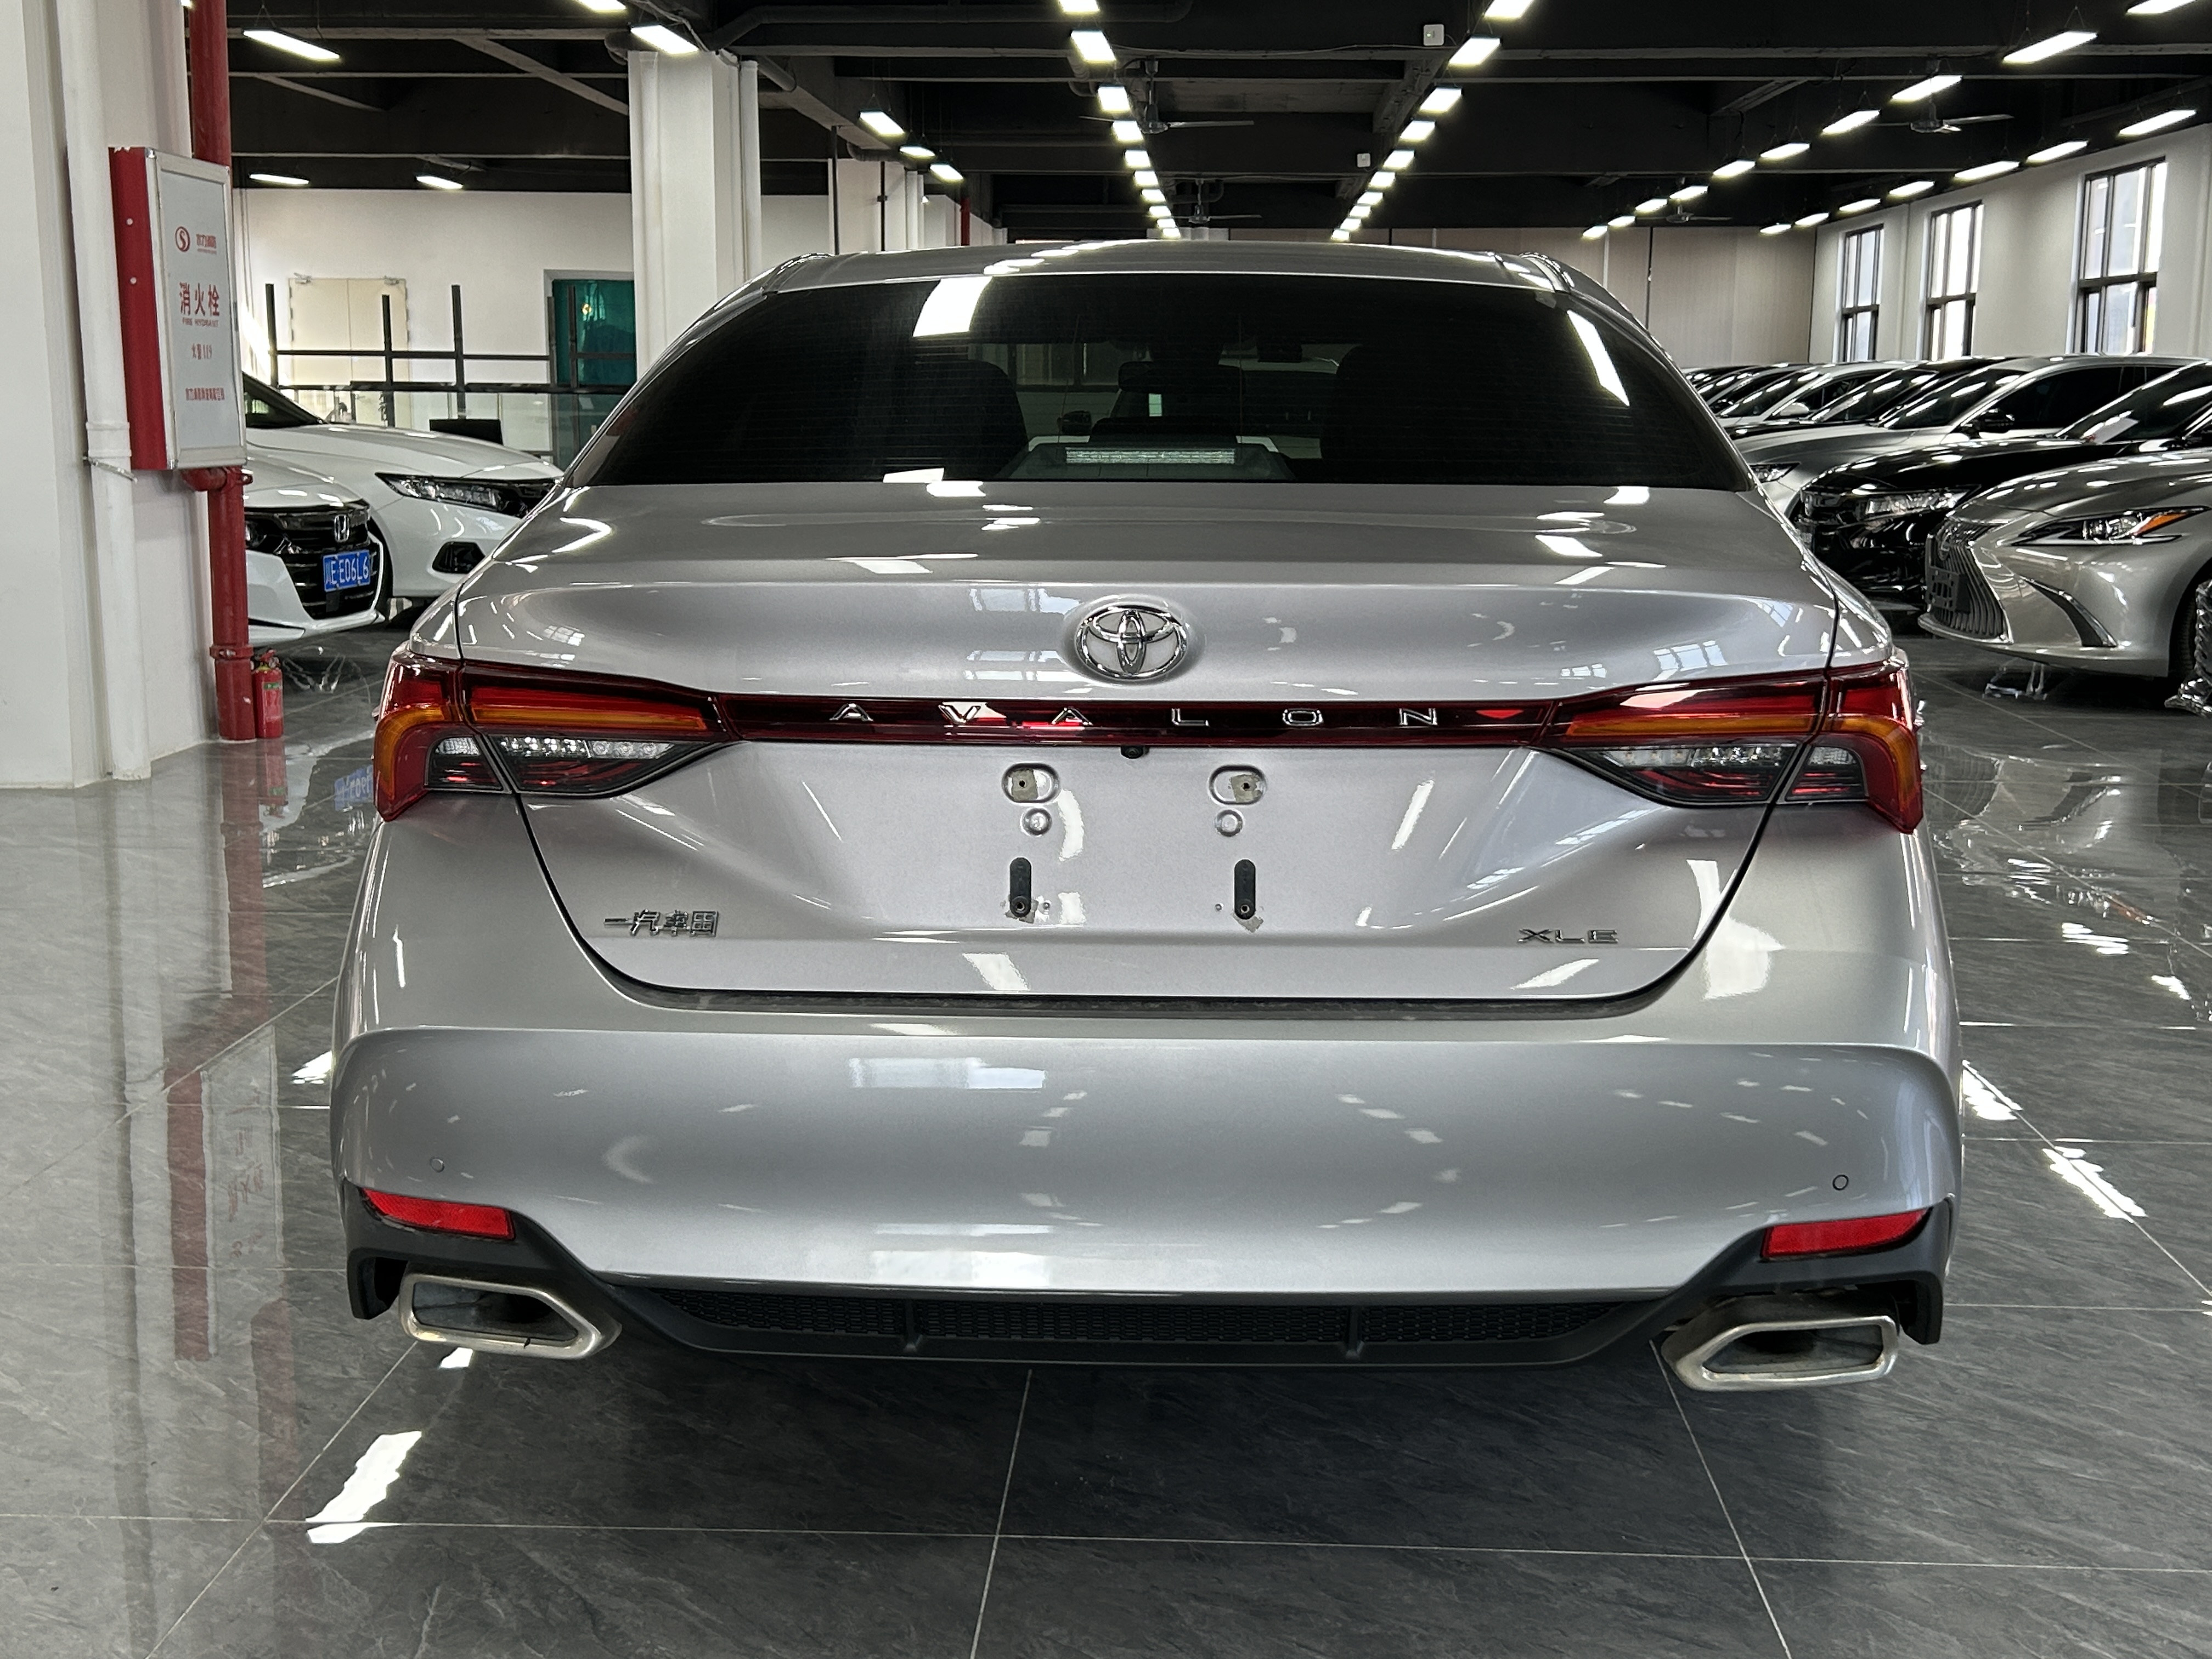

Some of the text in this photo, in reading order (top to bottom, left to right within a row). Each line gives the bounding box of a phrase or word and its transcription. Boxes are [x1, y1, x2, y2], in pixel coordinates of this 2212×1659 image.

[179, 281, 220, 317] 消火栓
[829, 702, 1438, 727] AVALON
[1517, 929, 1619, 944] XLE
